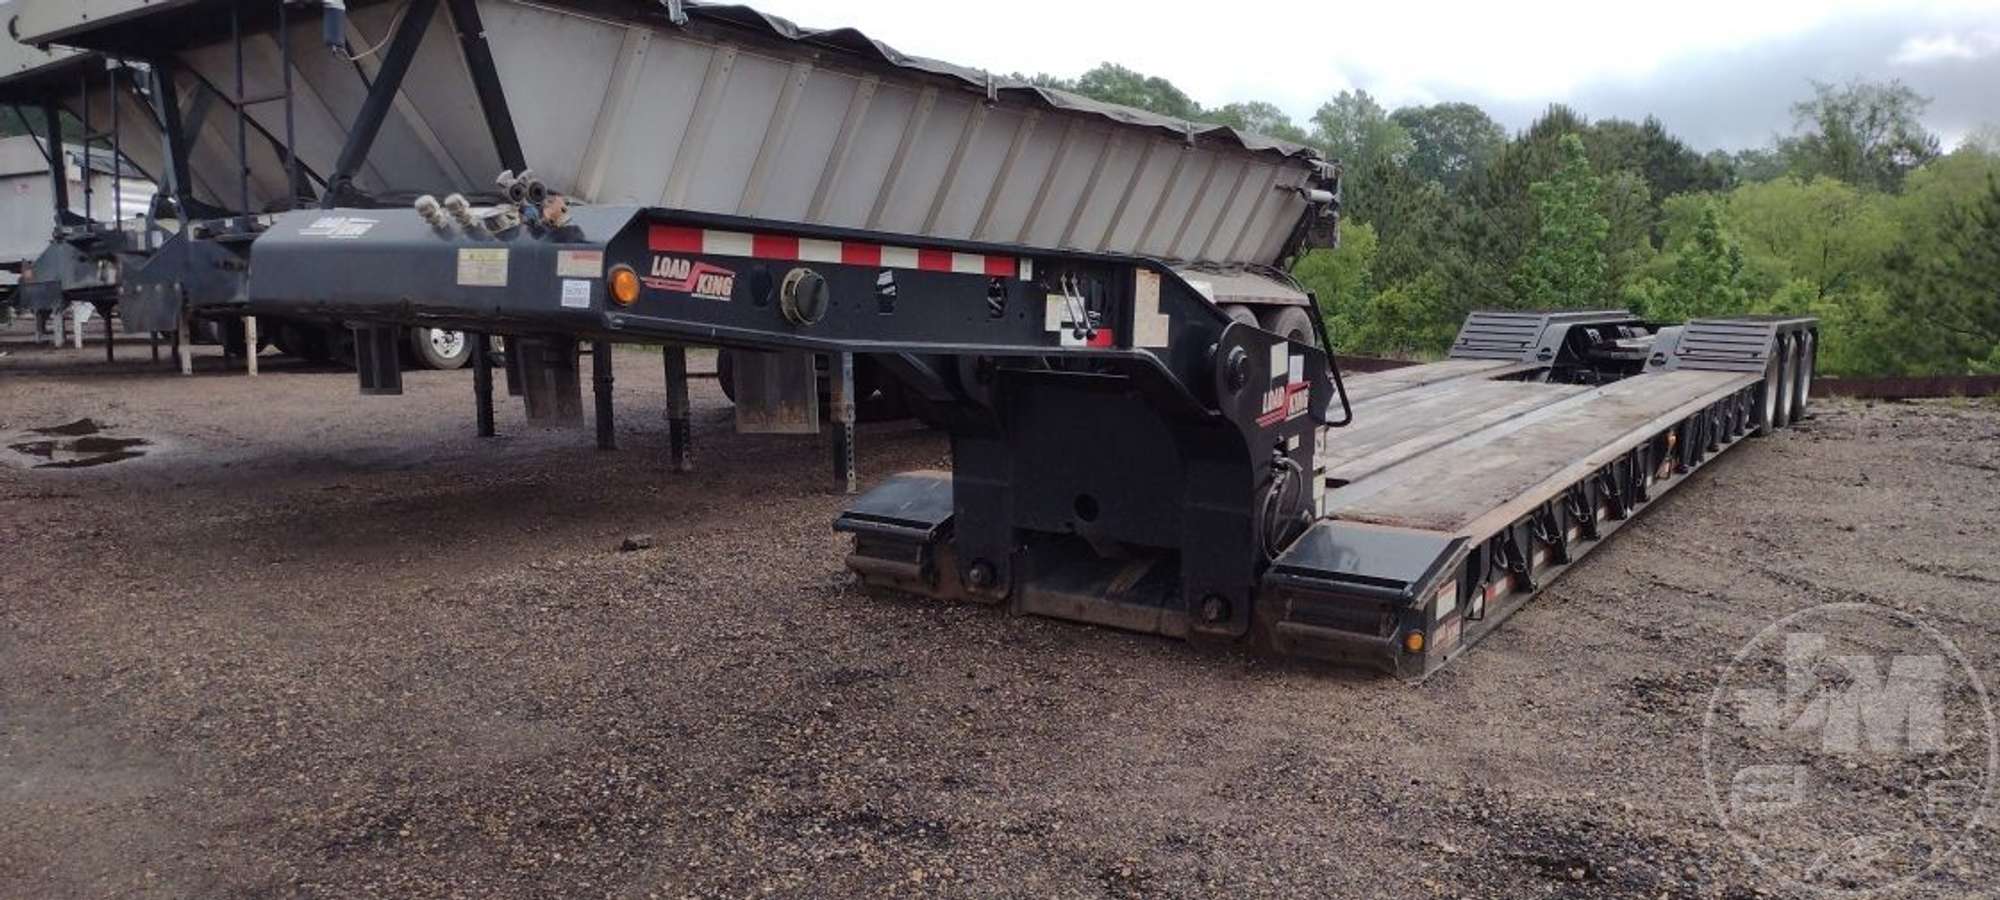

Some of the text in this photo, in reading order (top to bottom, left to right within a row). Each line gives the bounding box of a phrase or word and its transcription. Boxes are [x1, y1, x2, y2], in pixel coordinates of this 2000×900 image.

[651, 255, 733, 297] LOAD KING
[1262, 386, 1286, 415] LOAD
